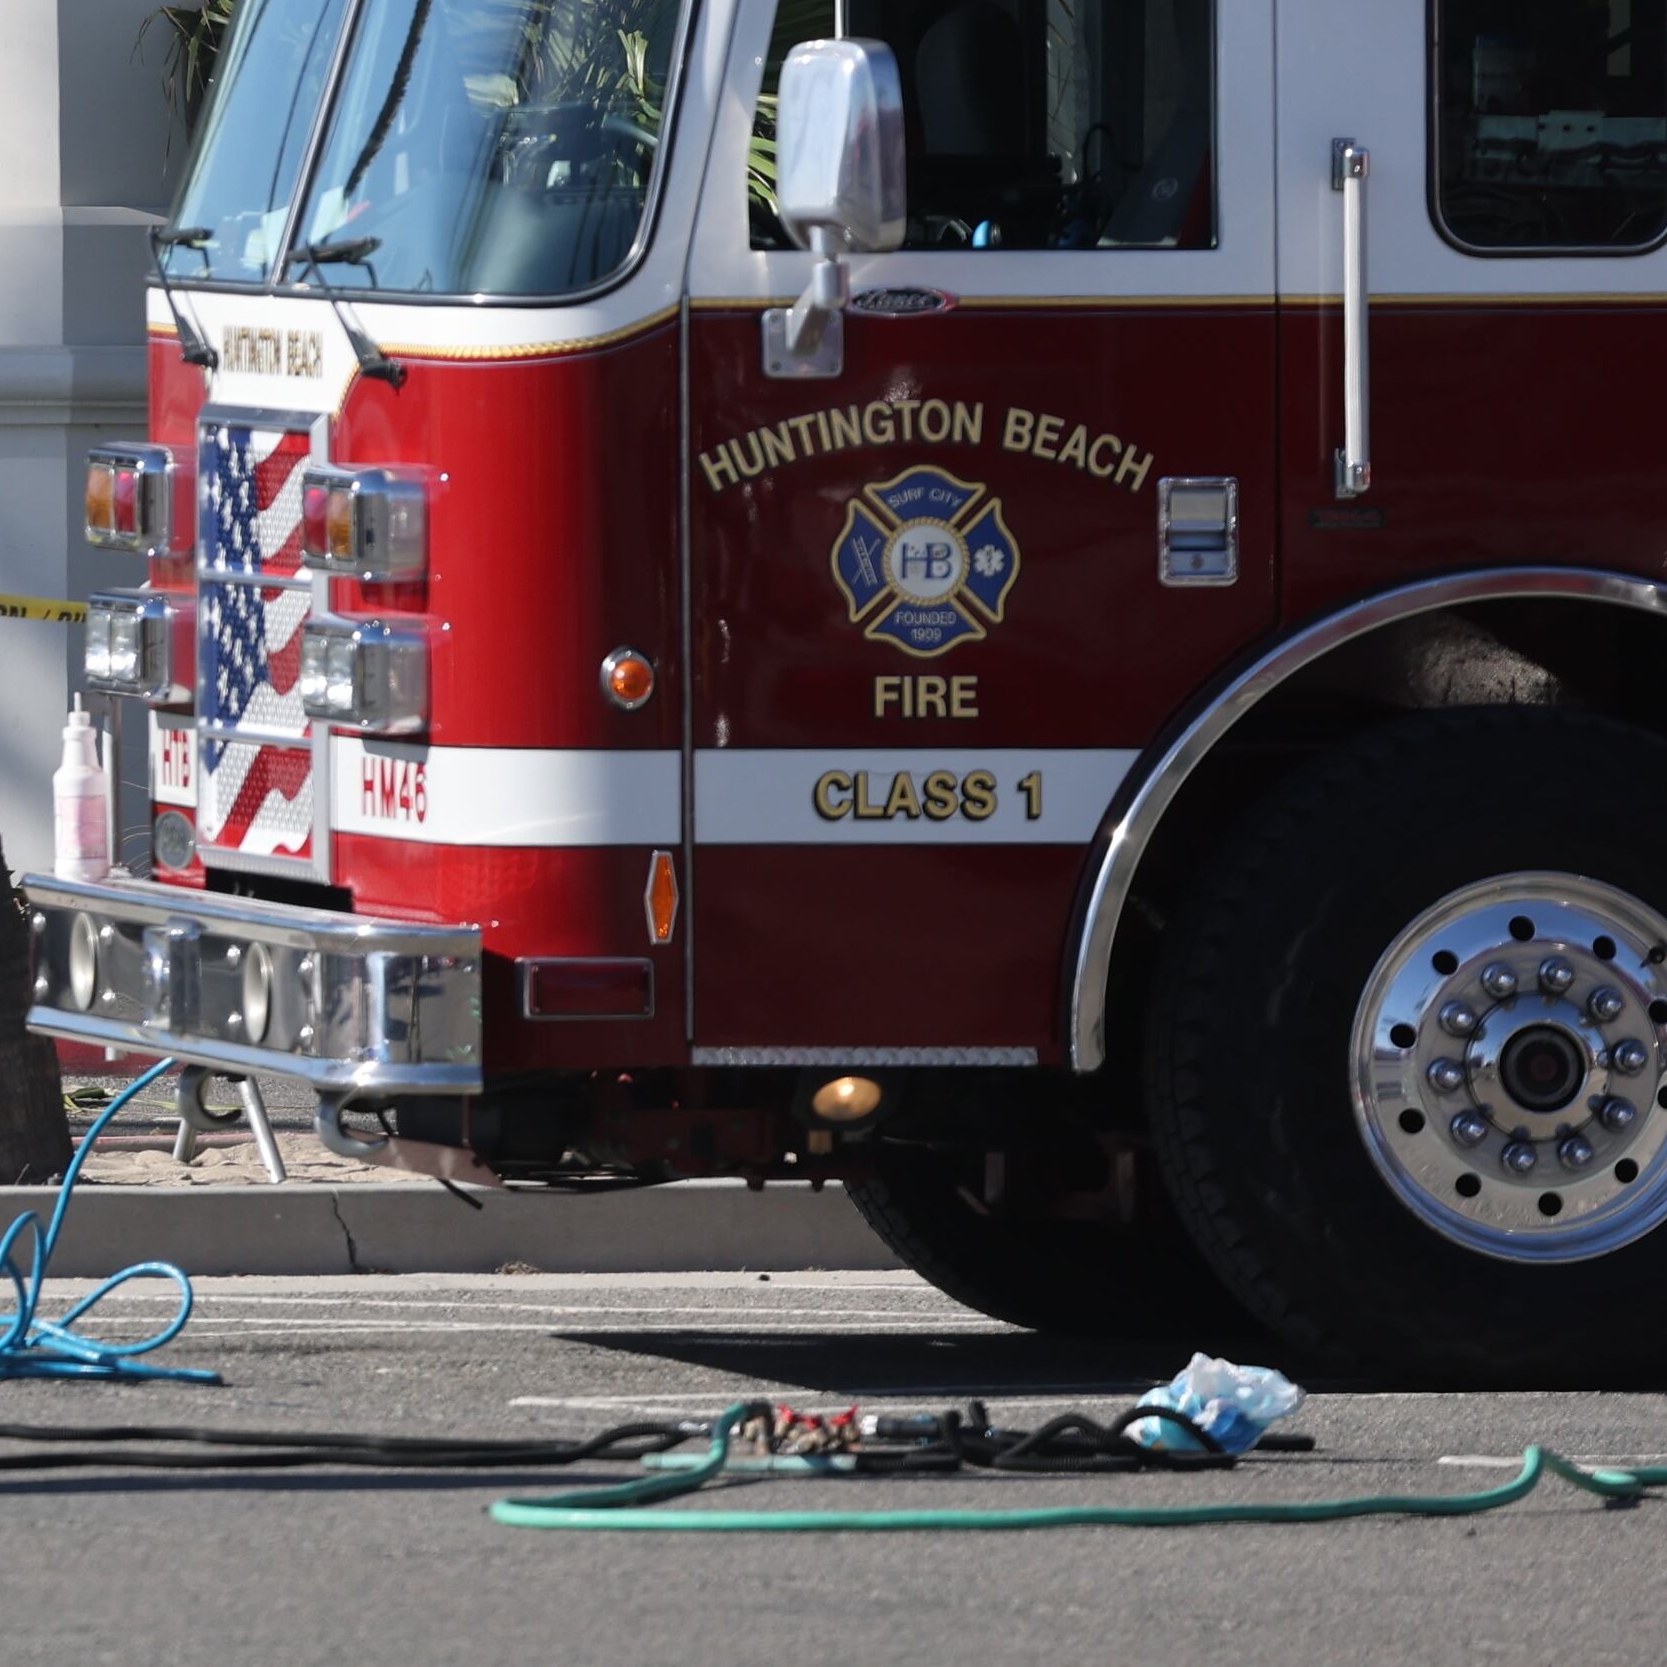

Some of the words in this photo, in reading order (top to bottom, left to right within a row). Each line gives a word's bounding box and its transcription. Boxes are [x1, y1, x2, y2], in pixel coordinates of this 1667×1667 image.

[698, 397, 984, 492] HUNTINGTON
[1002, 406, 1155, 493] BEACH
[887, 486, 926, 509] SURF
[928, 487, 963, 508] CITY
[900, 541, 954, 580] HB
[894, 611, 957, 625] FOUNDED
[873, 675, 980, 719] FIRE
[362, 755, 428, 824] HM46
[813, 768, 999, 821] CLASS
[1017, 770, 1043, 821] 1
